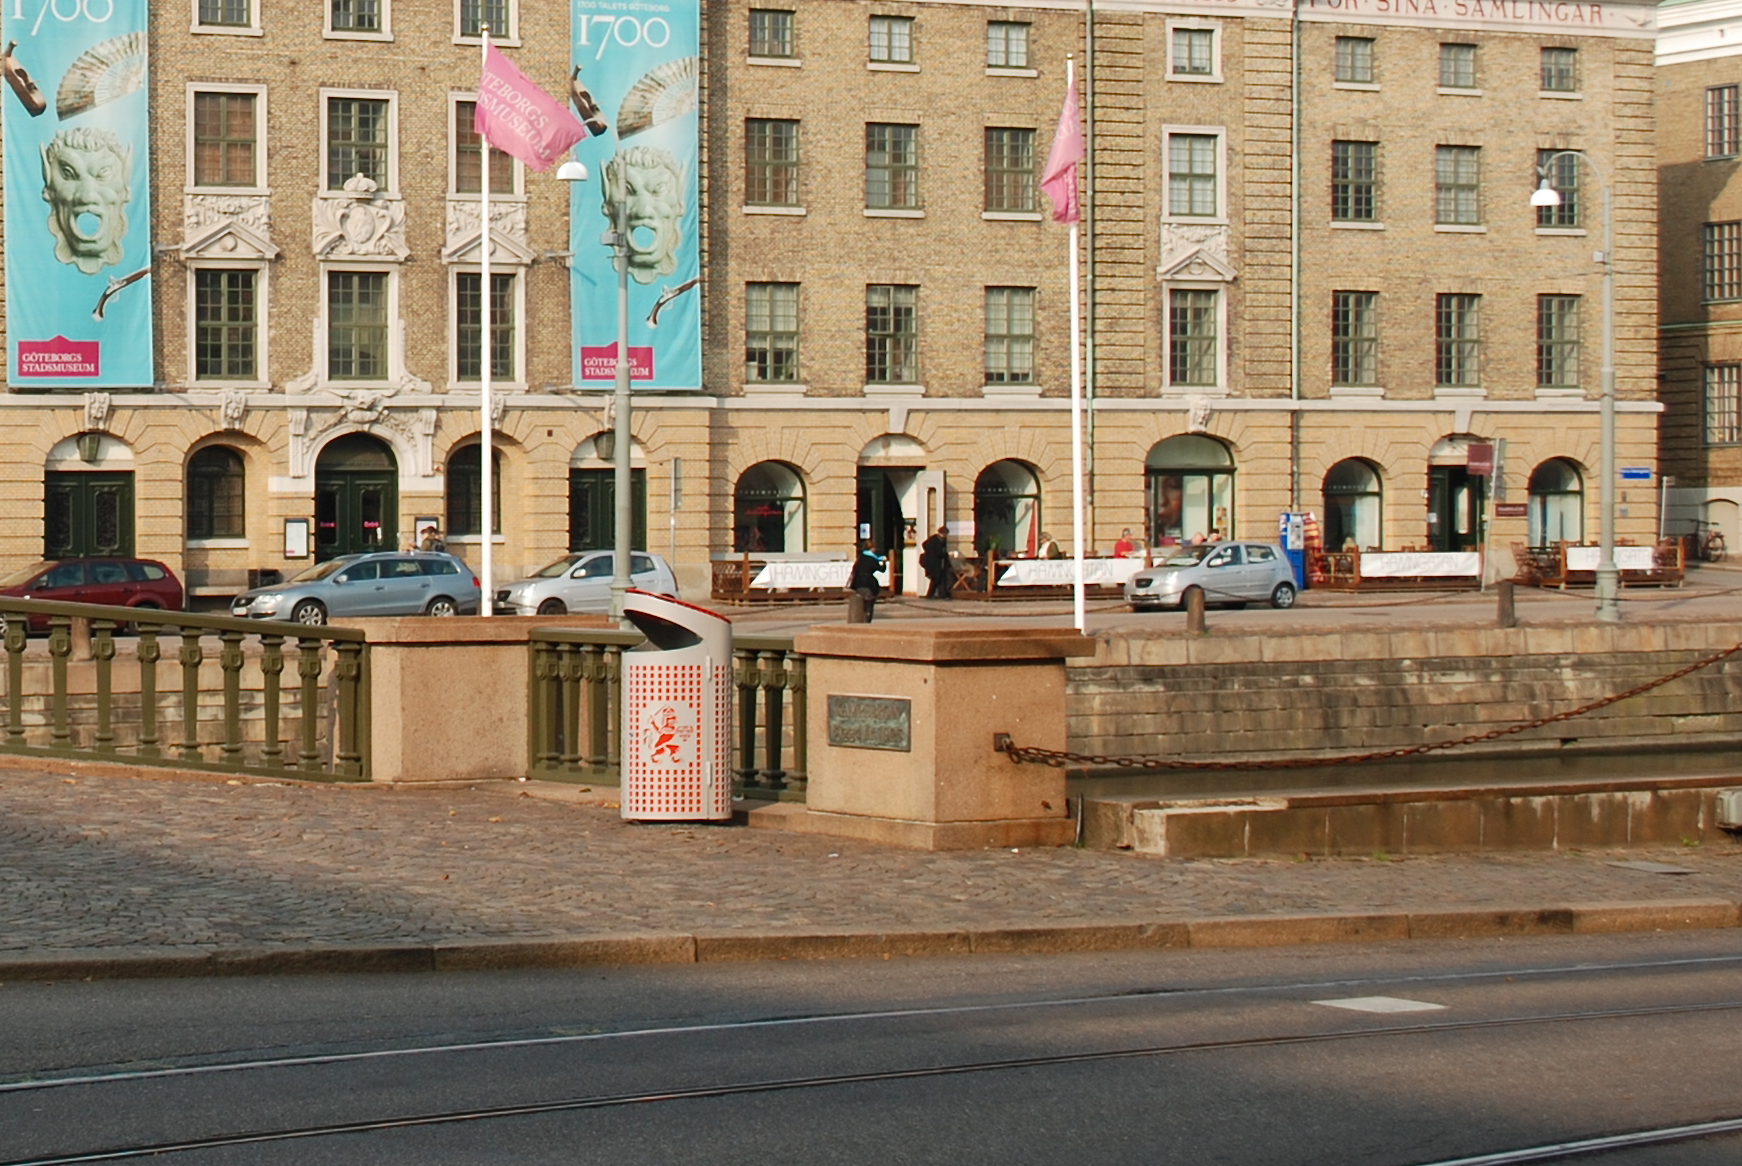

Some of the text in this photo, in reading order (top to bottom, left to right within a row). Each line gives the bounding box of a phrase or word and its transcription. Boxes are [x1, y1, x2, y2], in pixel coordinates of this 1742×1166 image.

[577, 14, 671, 61] 1700
[21, 353, 82, 363] GÖTEBORGS
[21, 363, 95, 373] STADSMUSEUM
